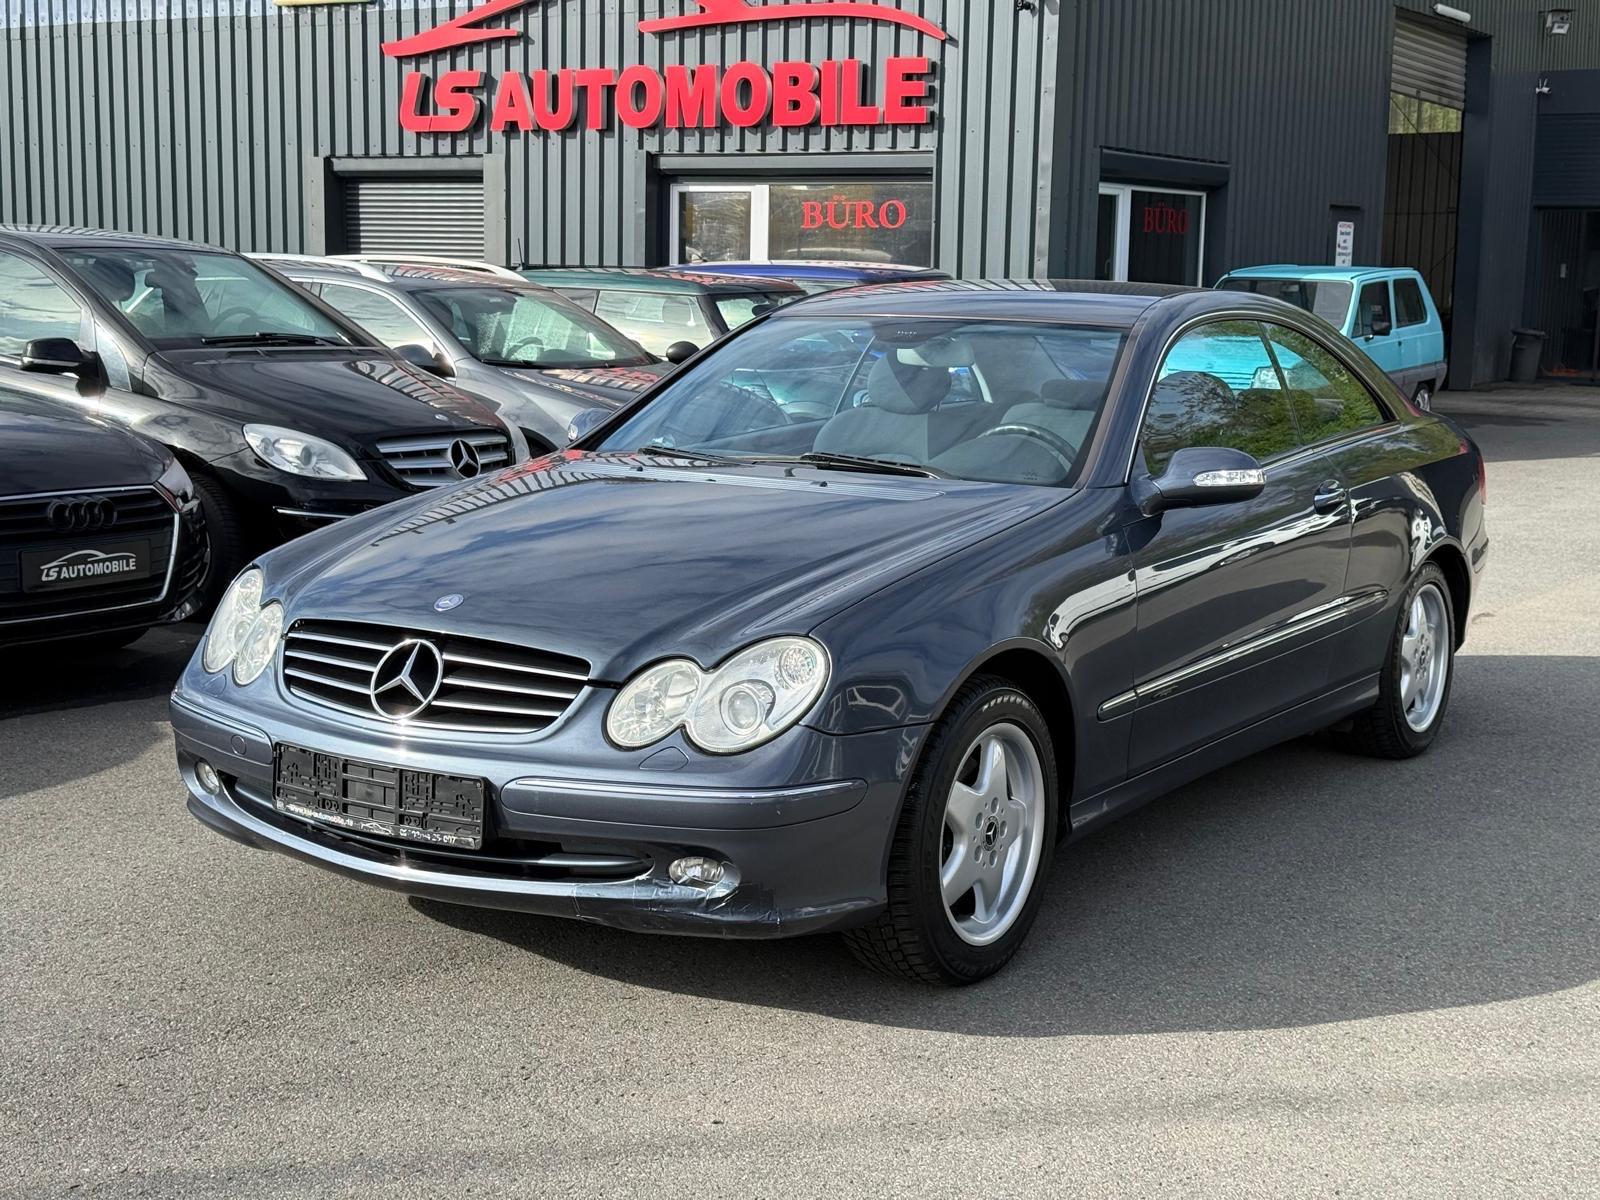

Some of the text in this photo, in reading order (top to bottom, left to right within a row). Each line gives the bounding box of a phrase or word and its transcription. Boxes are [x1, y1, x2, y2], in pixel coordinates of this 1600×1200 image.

[399, 56, 930, 133] LS AUTOMOBILE
[801, 194, 908, 230] BÜRO
[1143, 202, 1189, 234] BÜRO
[41, 559, 136, 581] LS AUTOMOBILE
